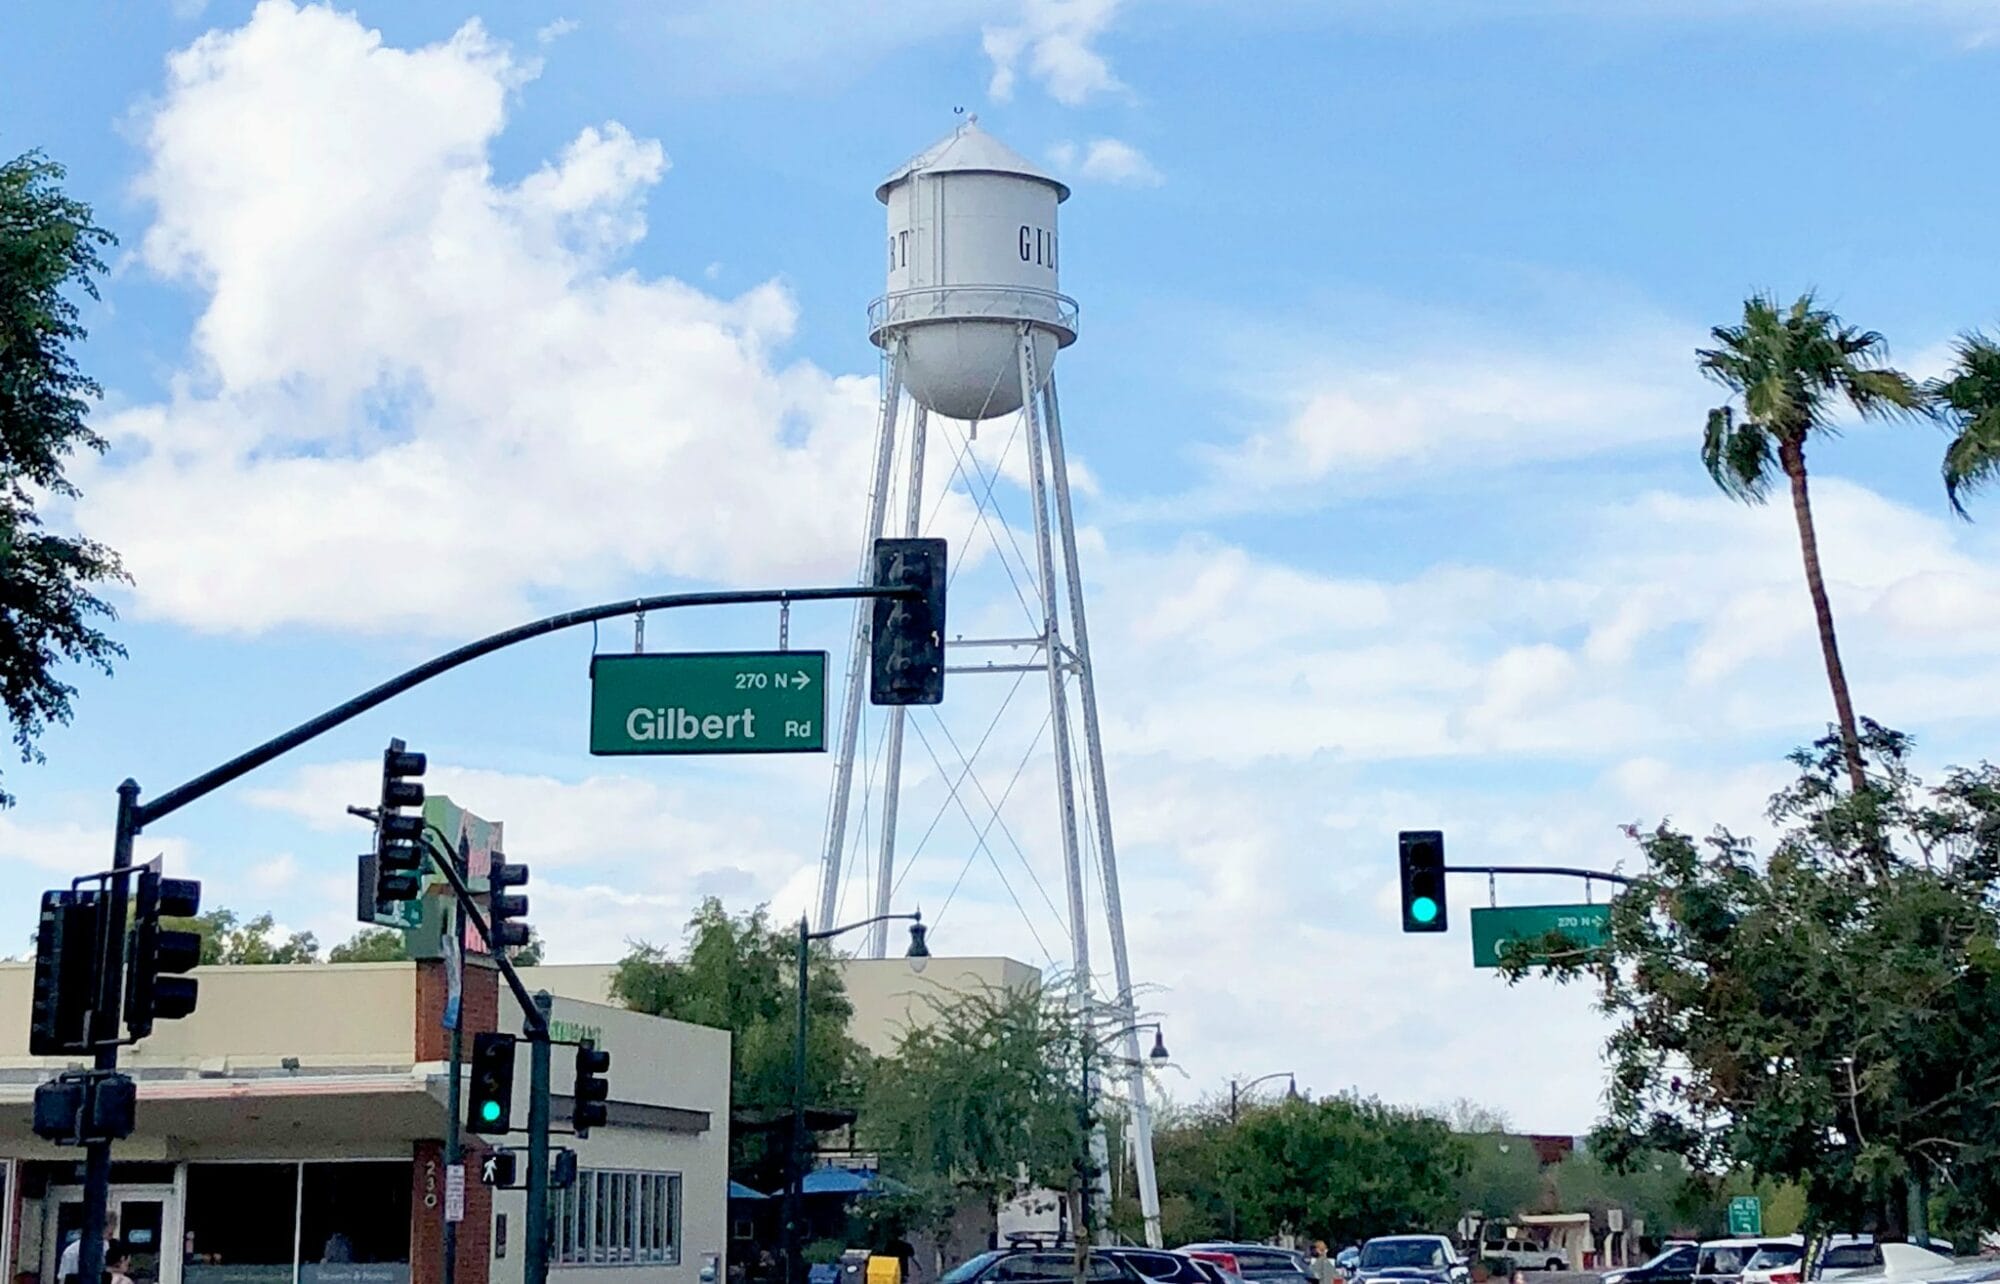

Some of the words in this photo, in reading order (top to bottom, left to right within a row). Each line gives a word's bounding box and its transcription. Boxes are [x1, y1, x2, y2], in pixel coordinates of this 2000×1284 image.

[735, 673, 768, 689] 270
[775, 672, 788, 688] N
[626, 707, 756, 741] Gilbert
[785, 720, 812, 738] Rd
[1557, 916, 1578, 928] 270
[1581, 916, 1590, 927] N
[424, 1160, 437, 1208] 230
